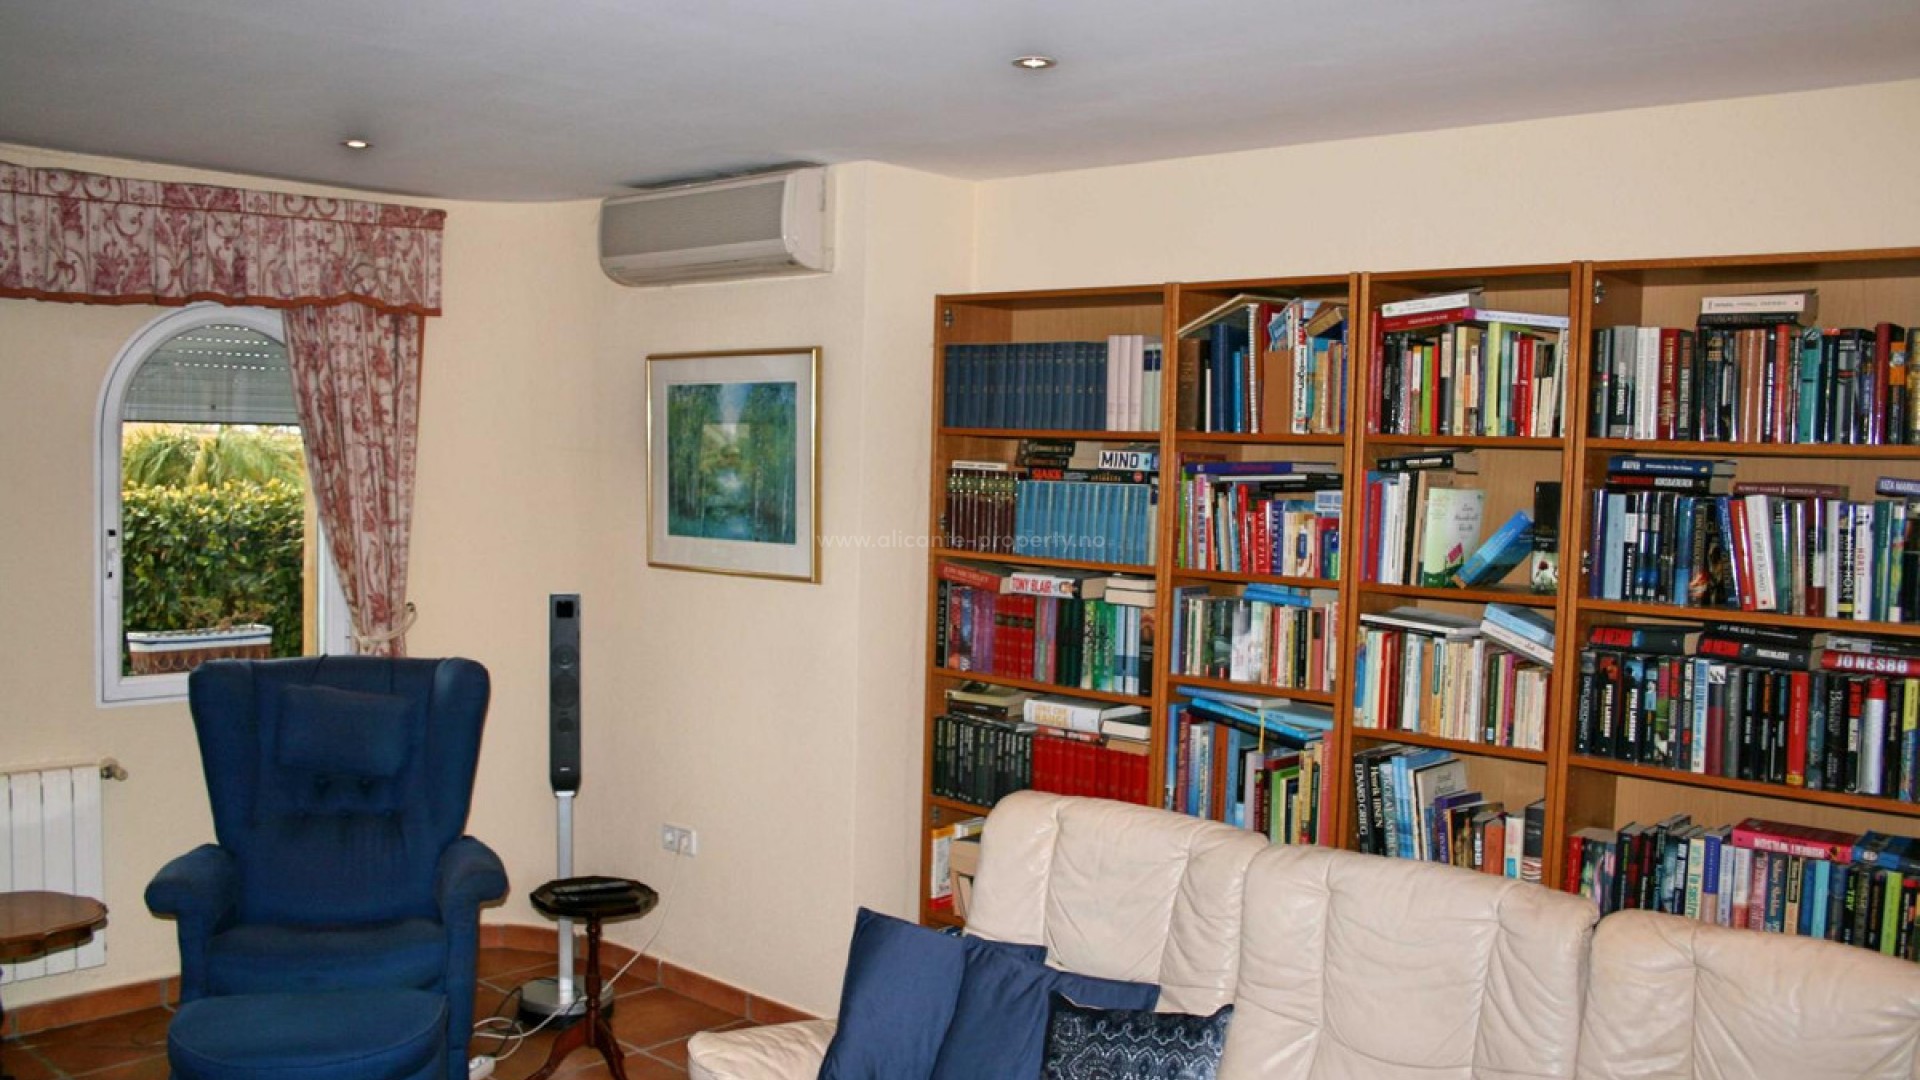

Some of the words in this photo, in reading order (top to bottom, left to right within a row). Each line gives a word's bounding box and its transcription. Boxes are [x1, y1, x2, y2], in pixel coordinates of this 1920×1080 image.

[1842, 570, 1854, 599] HOLT
[1834, 654, 1853, 669] JO
[1354, 763, 1366, 803] EDVARD
[1359, 803, 1369, 835] GRIEG
